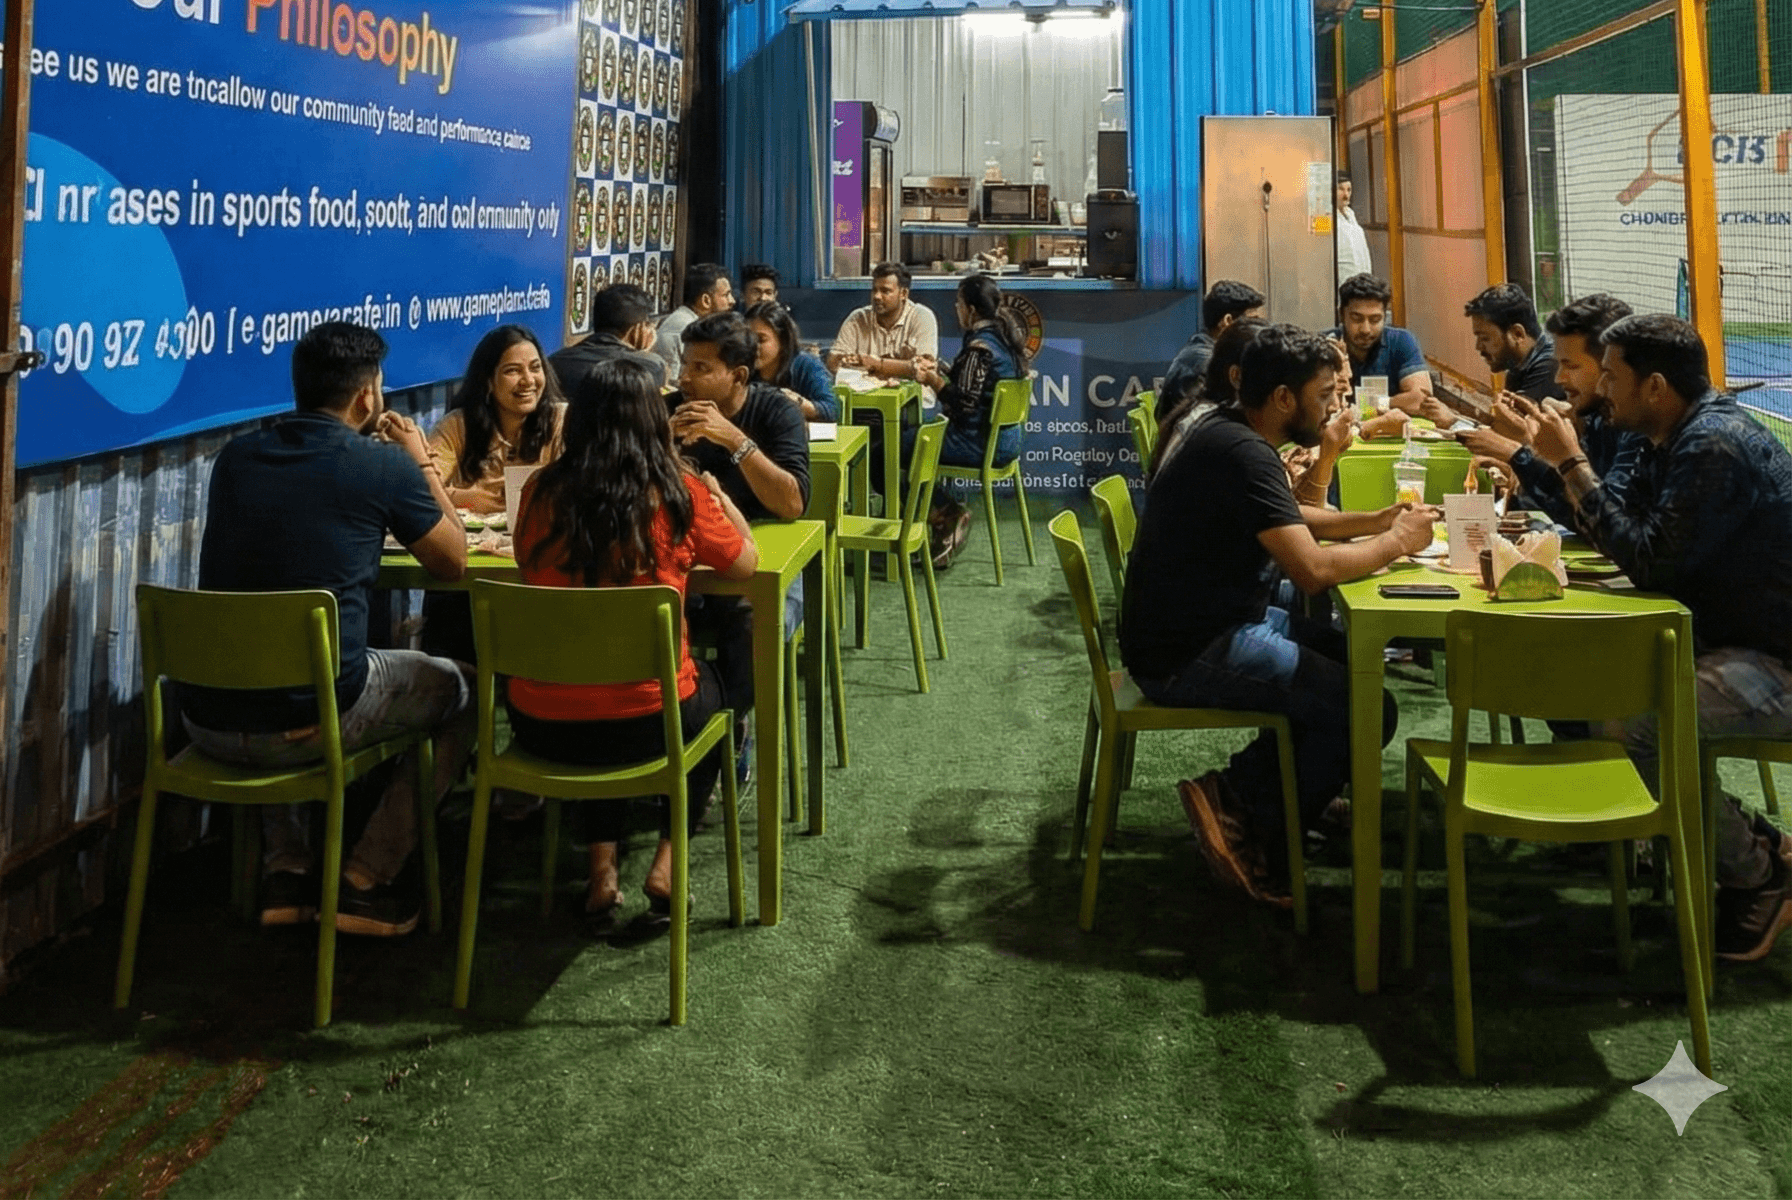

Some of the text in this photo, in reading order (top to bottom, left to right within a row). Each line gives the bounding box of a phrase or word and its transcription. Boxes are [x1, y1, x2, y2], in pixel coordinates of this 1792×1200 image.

[68, 54, 99, 84] us
[106, 61, 139, 90] we
[145, 68, 181, 97] are
[270, 91, 300, 116] our
[303, 96, 386, 135] community
[416, 113, 438, 137] and
[189, 178, 215, 226] in
[222, 186, 302, 238] sports
